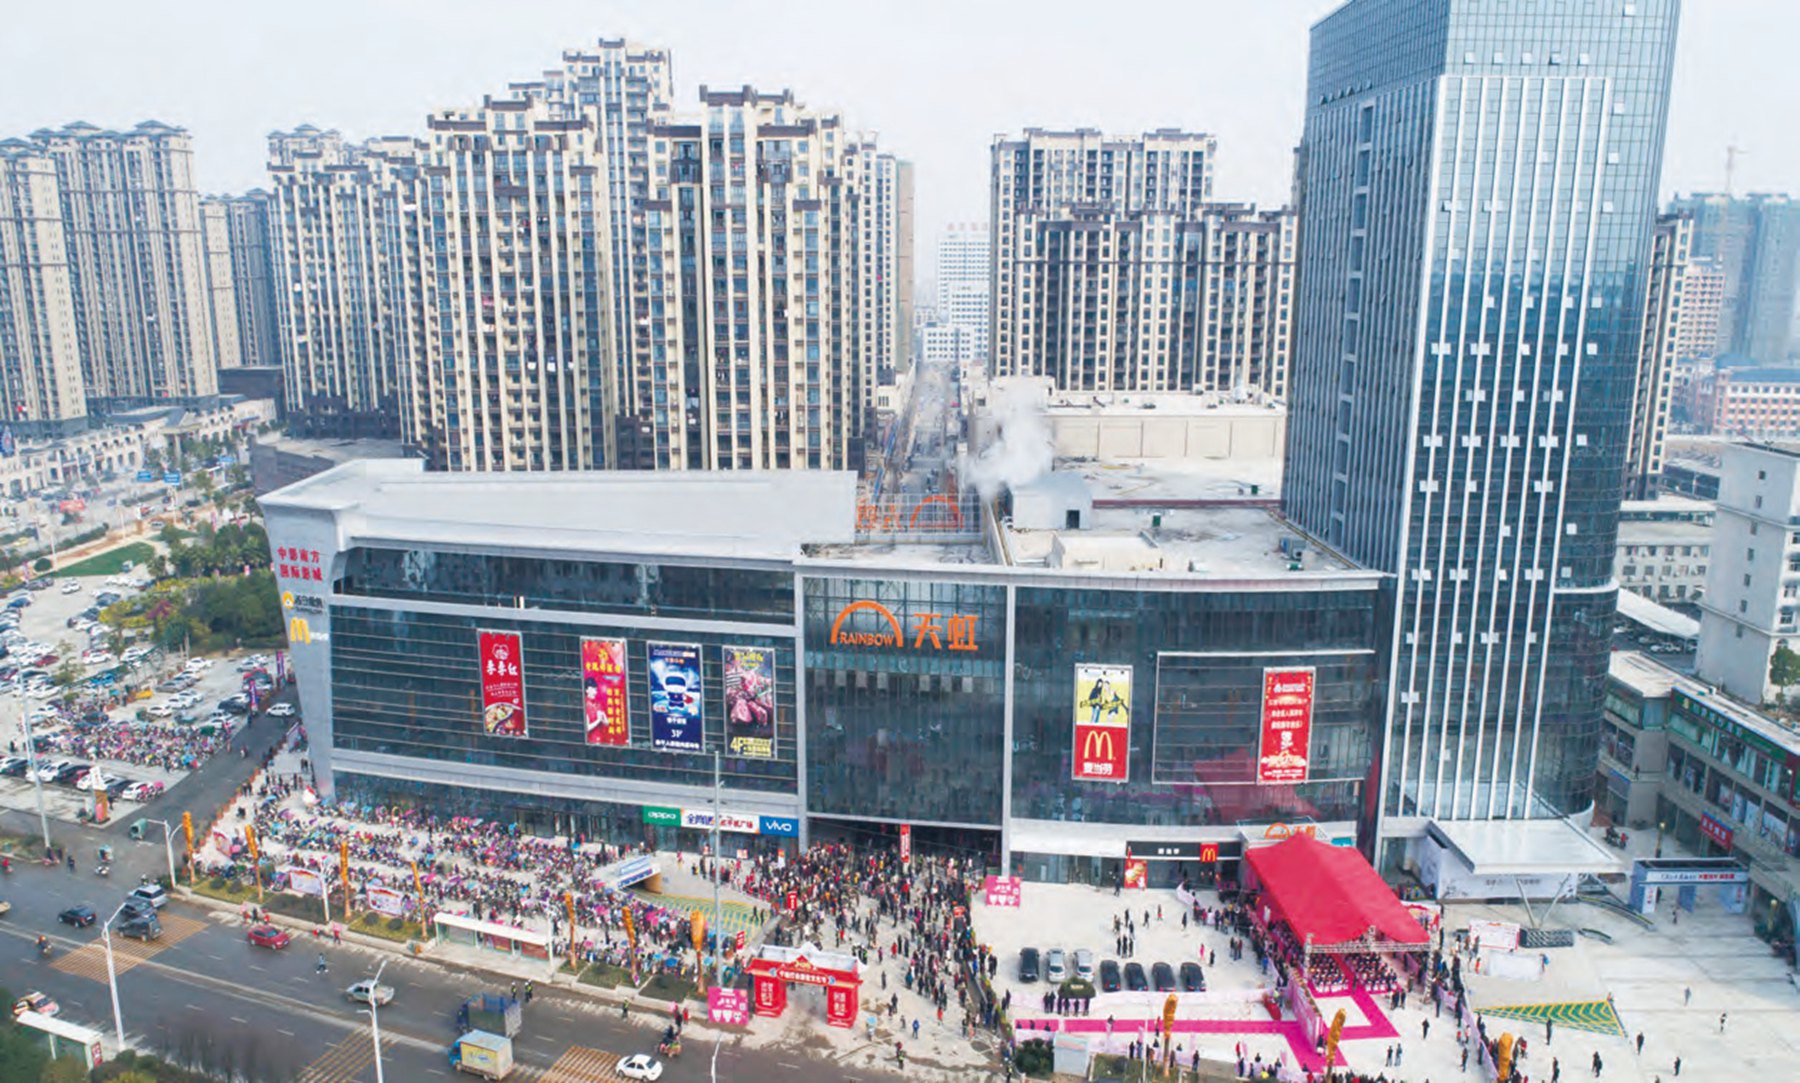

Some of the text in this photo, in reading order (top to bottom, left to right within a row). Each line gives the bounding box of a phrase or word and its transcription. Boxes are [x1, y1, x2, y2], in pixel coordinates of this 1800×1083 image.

[840, 630, 895, 648] RAINBOW
[912, 613, 979, 651] 天虹
[486, 659, 519, 676] 季季红
[1083, 761, 1113, 775] 麦当劳
[765, 821, 793, 832] vivo
